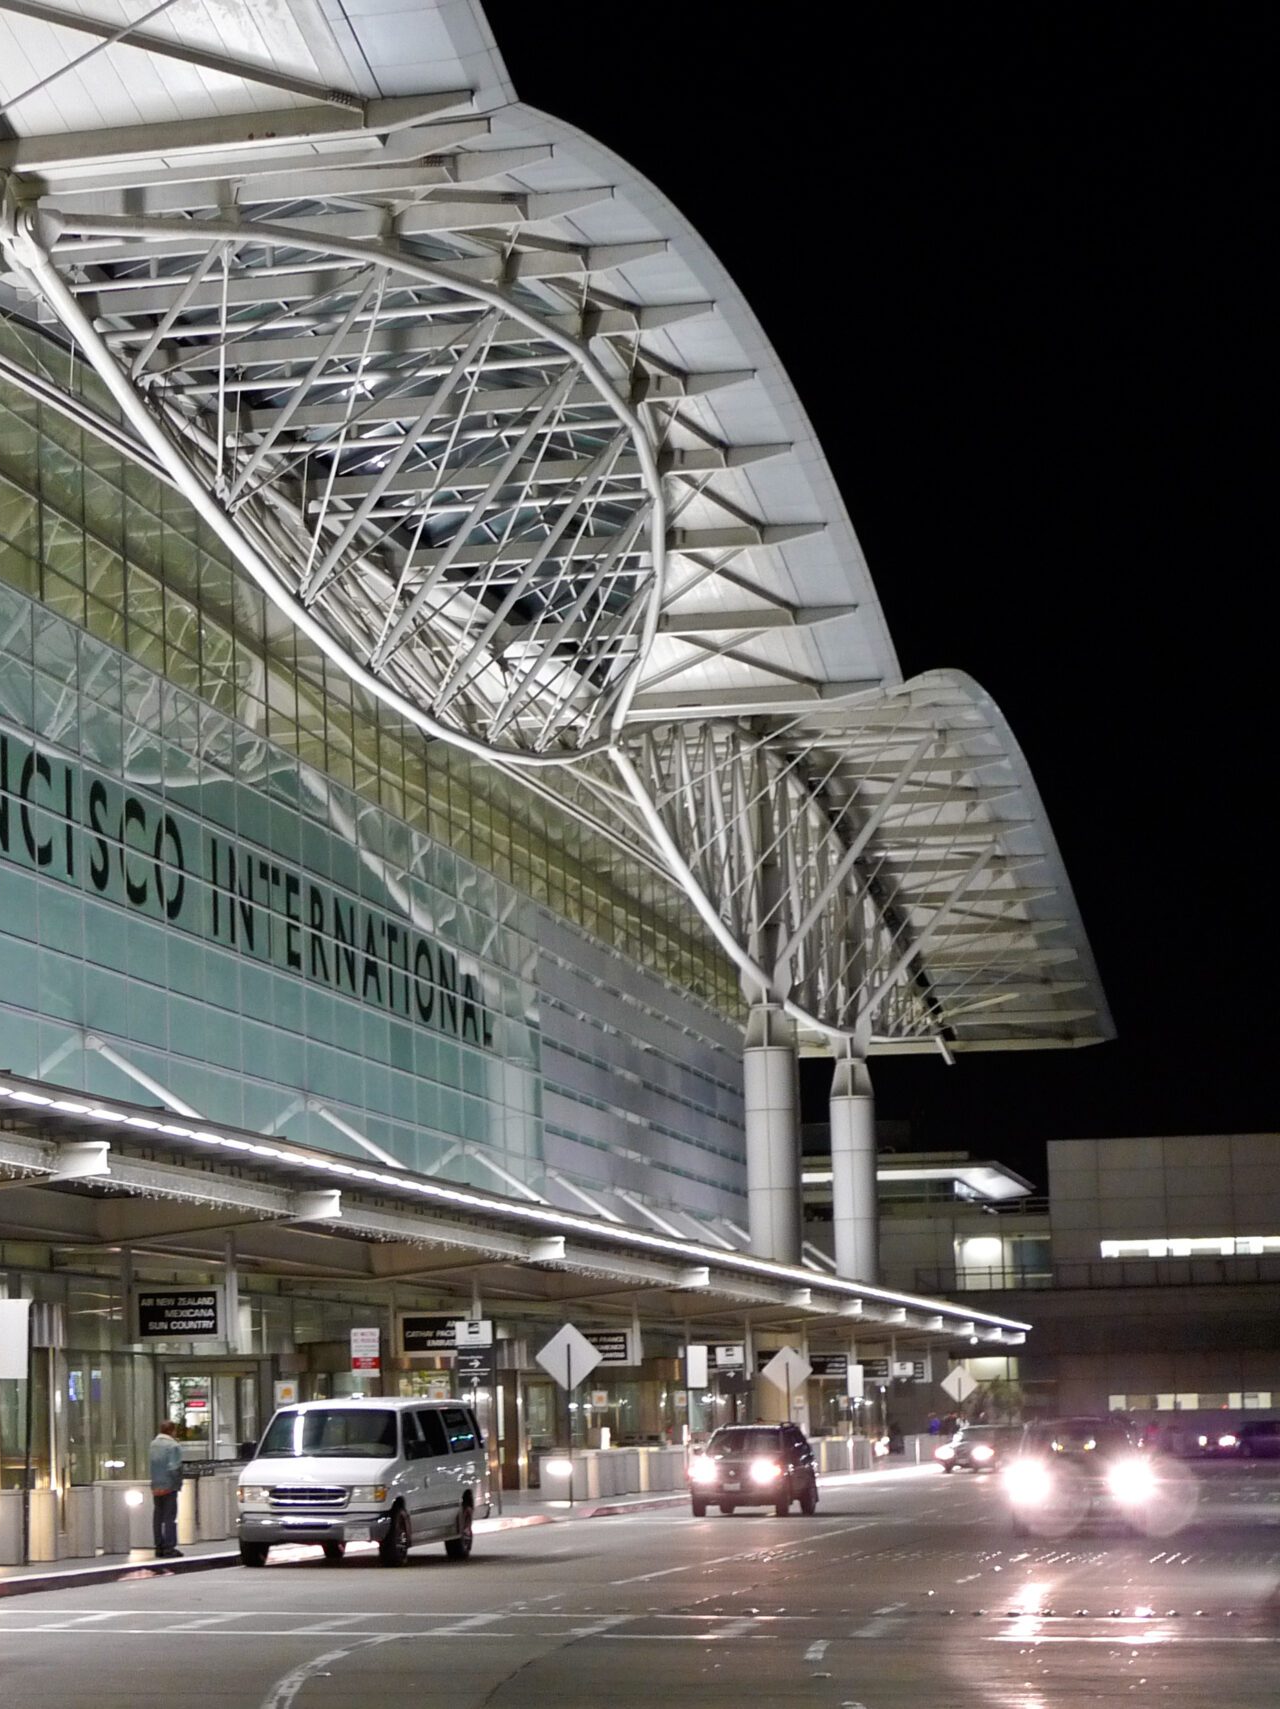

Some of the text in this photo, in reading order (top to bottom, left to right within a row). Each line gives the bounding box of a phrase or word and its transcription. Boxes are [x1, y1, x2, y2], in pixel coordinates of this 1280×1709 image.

[211, 838, 494, 1047] INTERNATIONAL
[141, 1297, 215, 1306] AIR NEW ZEALAND
[164, 1309, 215, 1318] MEXICANA
[148, 1320, 215, 1330] SUN COUNTRY
